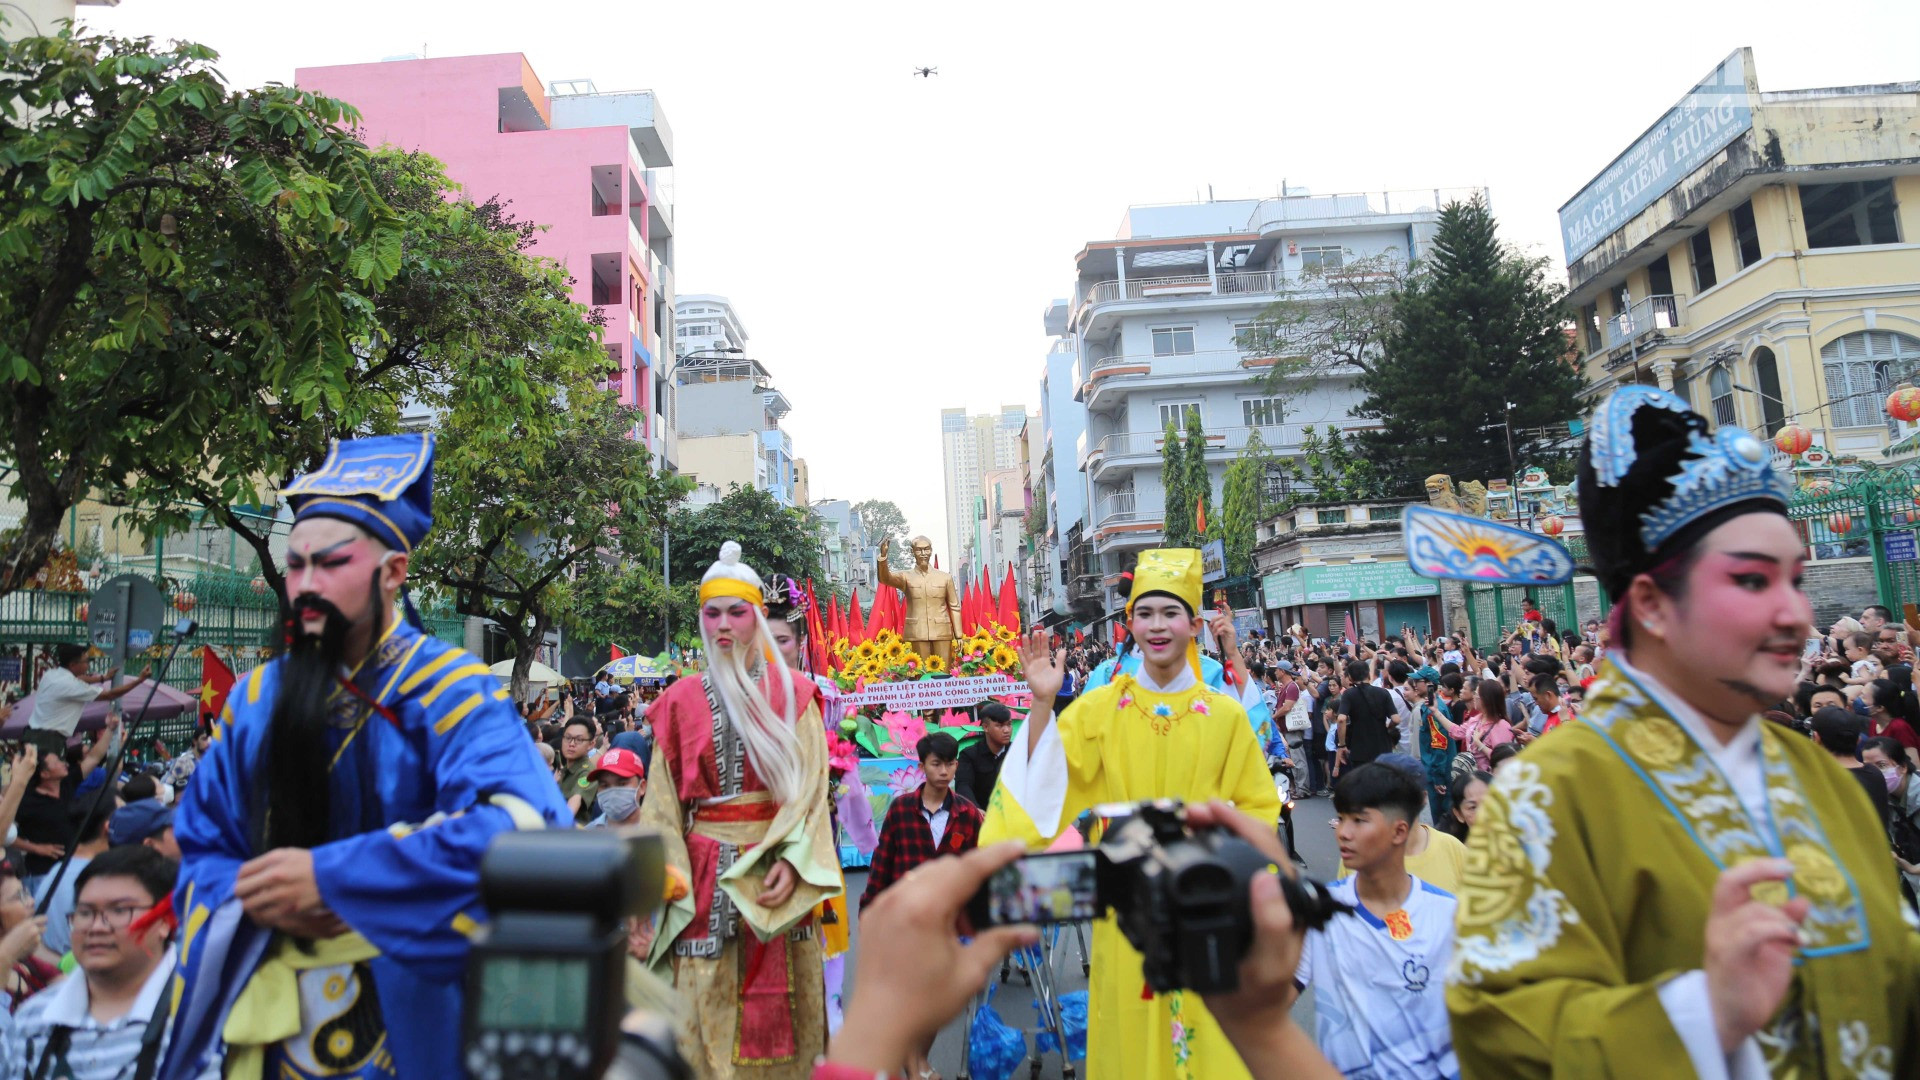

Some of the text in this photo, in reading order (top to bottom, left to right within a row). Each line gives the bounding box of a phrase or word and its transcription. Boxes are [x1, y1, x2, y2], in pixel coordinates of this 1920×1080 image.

[1594, 94, 1698, 195] TRƯỜNG TRUNG HỌC CƠ SỞ
[1568, 193, 1616, 247] MẠCH
[1617, 149, 1668, 207] KIẾM
[1671, 95, 1735, 164] HÙNG
[615, 661, 632, 671] be
[841, 695, 864, 703] NGÀY
[867, 693, 897, 702] THÀNH
[899, 691, 916, 700] LẬP
[918, 689, 943, 697] ĐẢNG
[945, 688, 970, 697] CỘNG
[972, 685, 990, 693] SẢN
[992, 684, 1012, 693] VIỆT
[867, 684, 894, 693] NHIỆT
[896, 683, 915, 691] LIỆT
[917, 681, 942, 689] CHÀO
[944, 678, 971, 687] MỪNG
[986, 676, 1005, 684] NĂM
[889, 700, 934, 709] 03/02/1930
[941, 696, 986, 706] 03/02/2025
